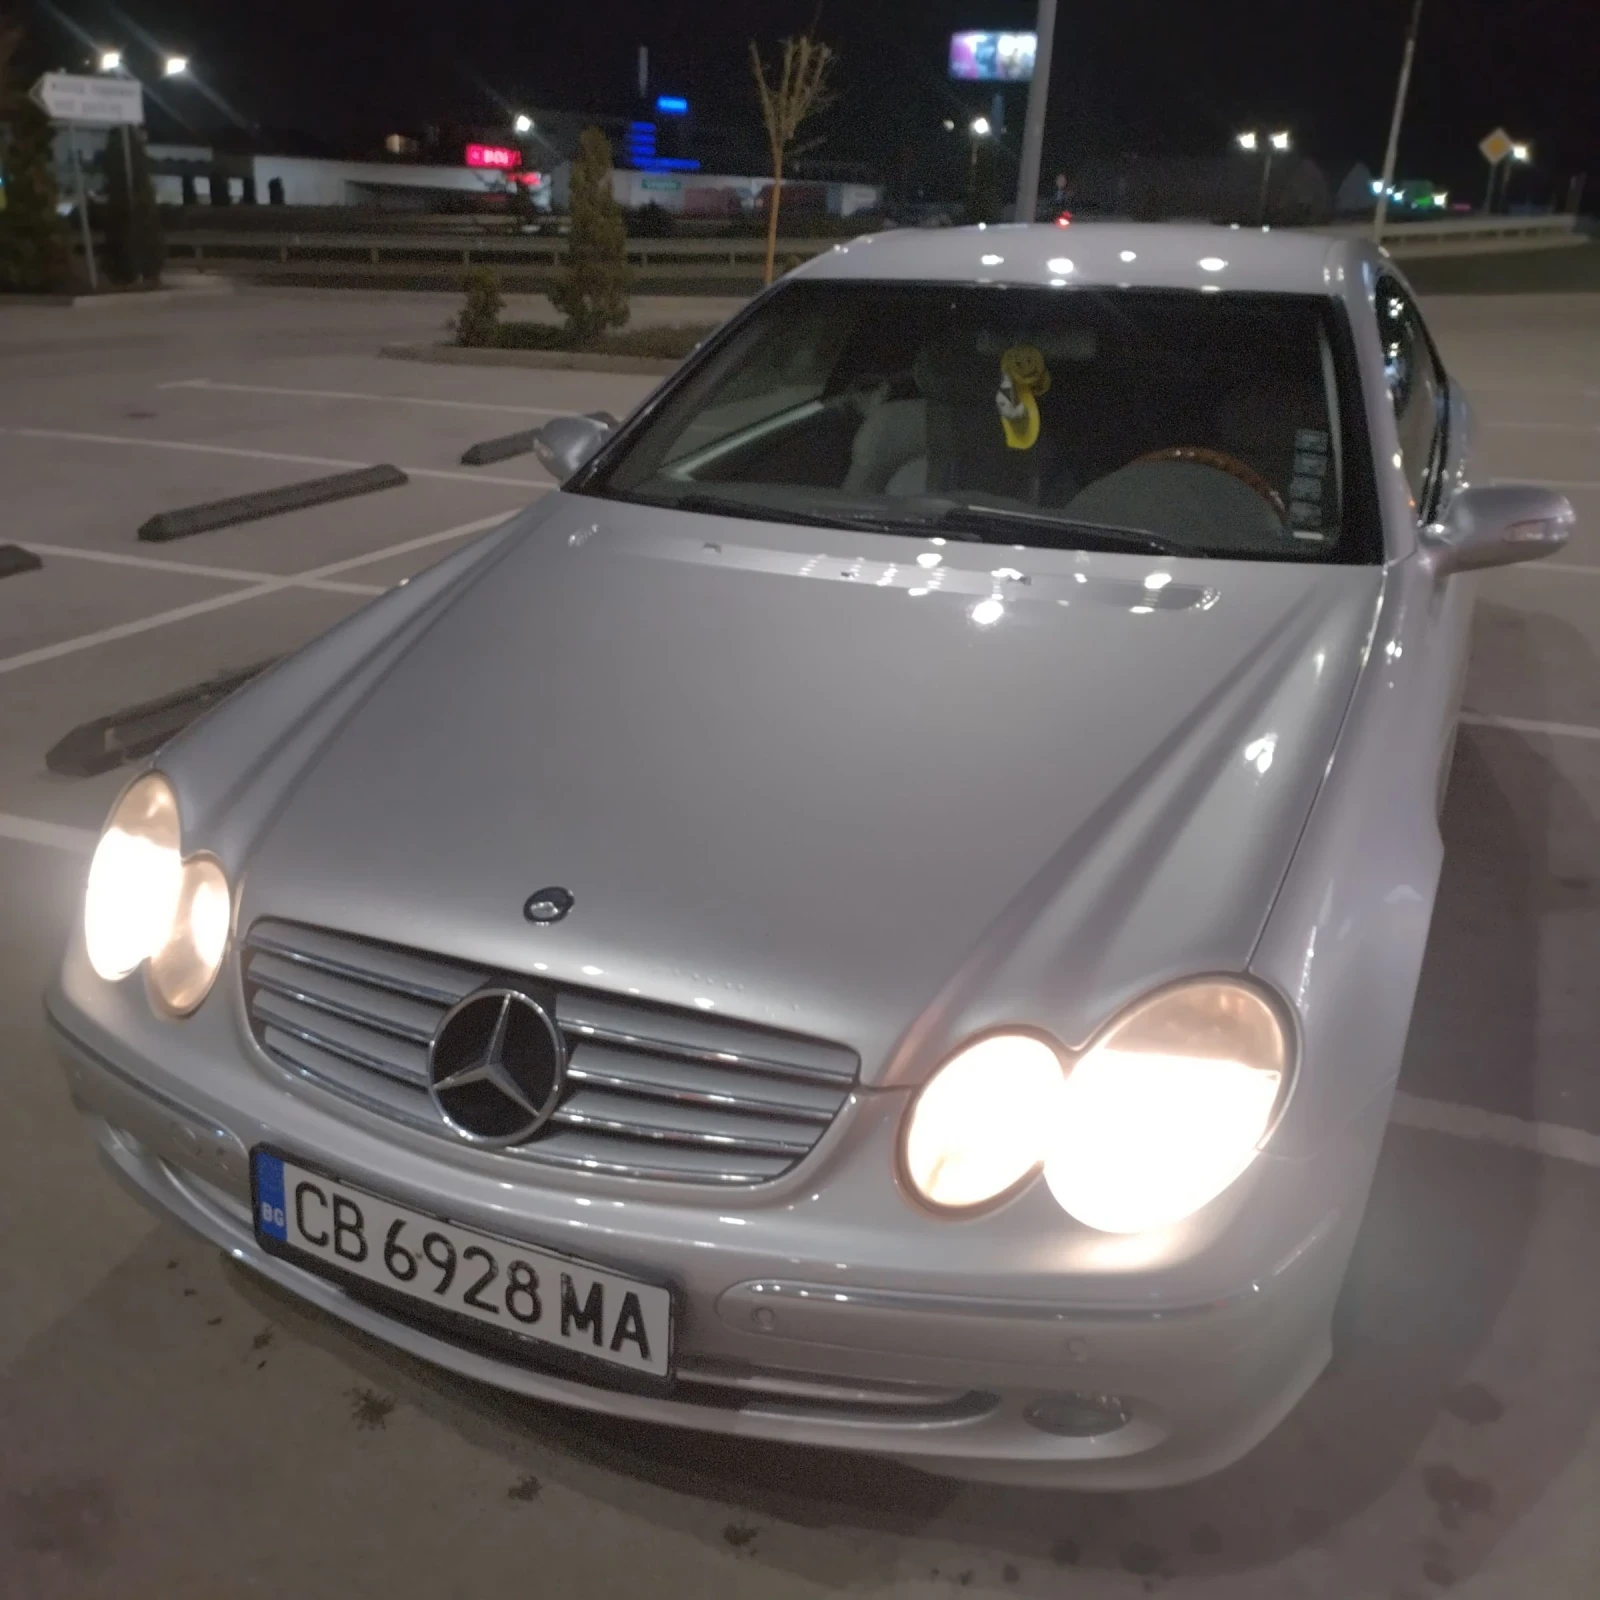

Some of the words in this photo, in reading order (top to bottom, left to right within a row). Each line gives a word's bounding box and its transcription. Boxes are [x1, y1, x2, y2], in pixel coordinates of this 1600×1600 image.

[262, 1202, 284, 1226] BG
[295, 1181, 368, 1263] CB
[384, 1219, 542, 1325] 6928
[560, 1272, 652, 1360] MA
